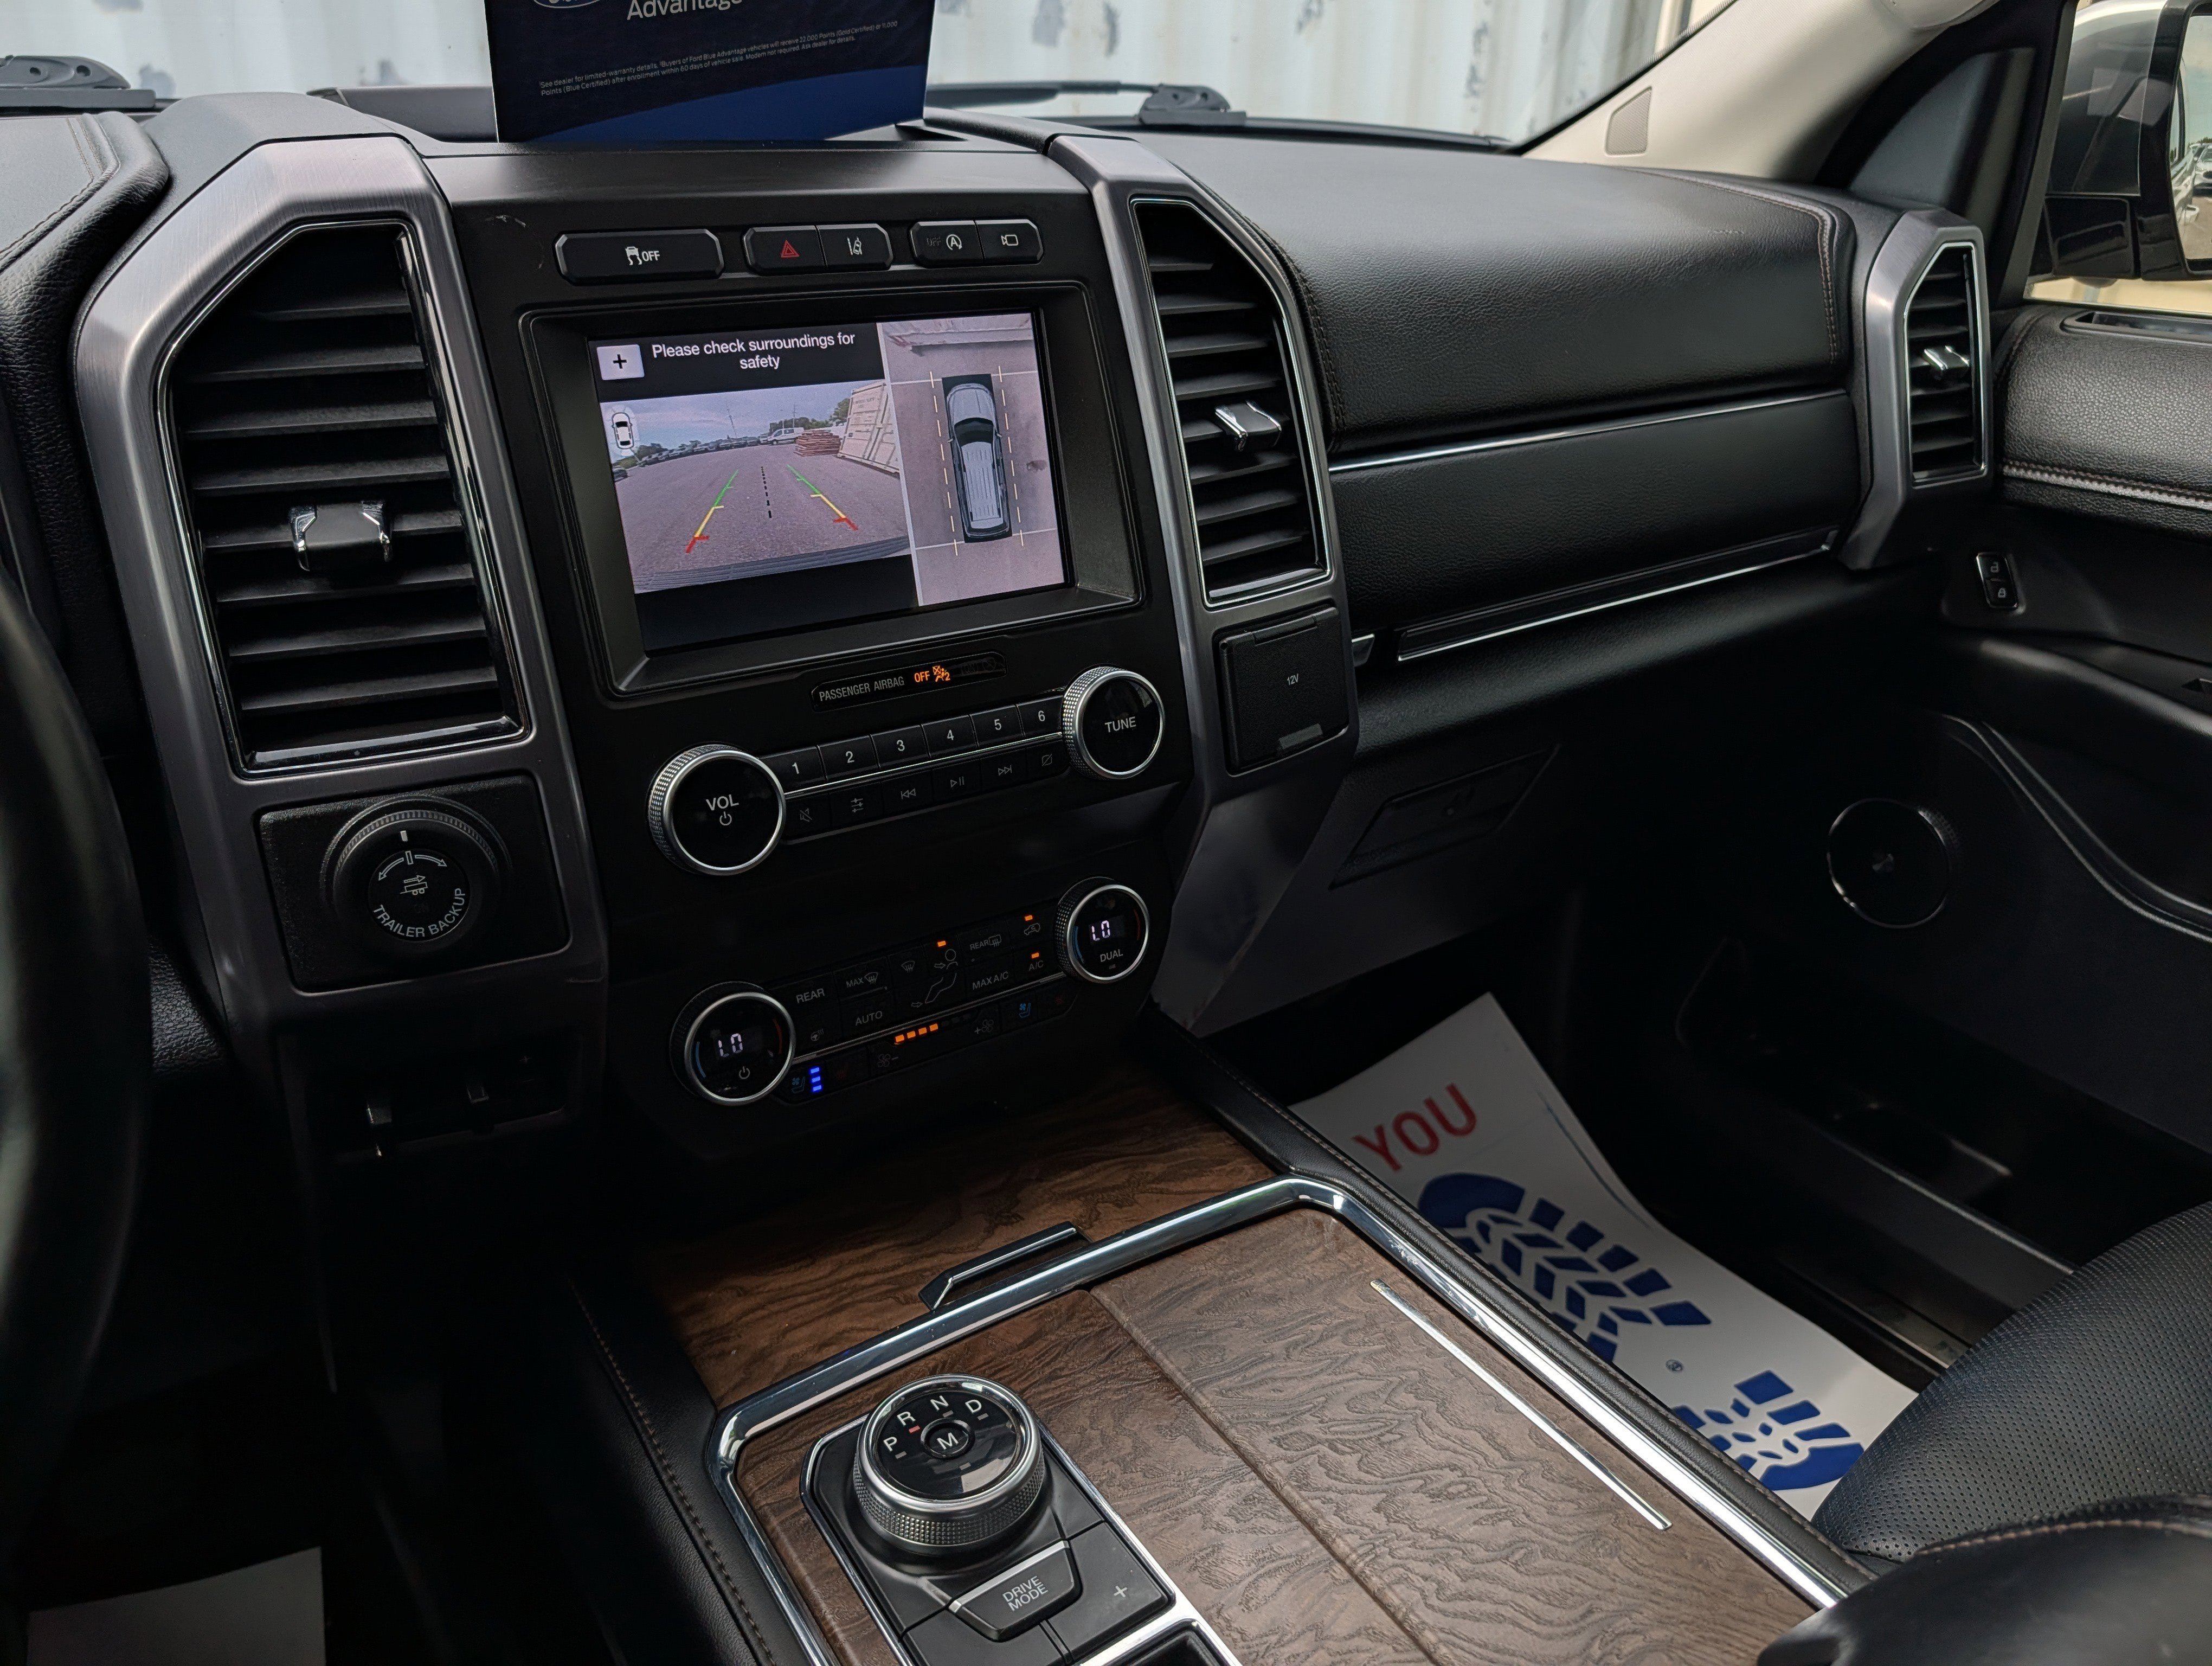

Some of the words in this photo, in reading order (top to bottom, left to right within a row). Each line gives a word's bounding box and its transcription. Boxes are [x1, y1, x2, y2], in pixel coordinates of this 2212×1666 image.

[636, 63, 658, 72] details.
[703, 52, 716, 60] Blue
[717, 48, 747, 57] Advantage
[747, 43, 769, 52] vehicles
[563, 84, 580, 93] (Blue
[581, 78, 611, 89] Certified)
[627, 70, 660, 81] enrollment
[661, 67, 680, 75] within
[711, 58, 731, 66] vehicle
[642, 251, 660, 262] OFF
[652, 343, 700, 358] Please
[703, 338, 746, 355] check
[748, 334, 834, 352] surroundings
[837, 331, 855, 347] for
[739, 354, 780, 370] safety
[819, 685, 871, 701] PASSENGER
[873, 676, 905, 691] AIRBAG
[914, 671, 930, 683] OFF
[1287, 673, 1299, 685] 12V
[1104, 716, 1137, 733] TUNE
[792, 762, 800, 774] 1
[845, 751, 854, 764] 2
[896, 739, 906, 752] 3
[946, 729, 955, 741] 4
[994, 719, 1002, 731] 5
[1038, 710, 1046, 722] 6
[705, 794, 740, 811] VOL
[373, 904, 426, 938] TRAILER
[428, 887, 466, 935] BACKUP
[969, 939, 989, 951] REAR
[1099, 949, 1124, 963] DUAL
[1028, 960, 1044, 972] A/C
[846, 977, 865, 988] MAX
[972, 976, 993, 990] MAX
[993, 970, 1009, 983] A/C
[796, 988, 825, 1004] REAR
[856, 1010, 883, 1026] AUTO
[1353, 1082, 1477, 1171] YOU
[930, 1395, 949, 1411] N
[964, 1399, 982, 1414] D
[896, 1411, 916, 1426] R
[883, 1436, 898, 1452] P
[936, 1432, 959, 1450] M
[1002, 1575, 1042, 1602] DRIVE
[1008, 1584, 1049, 1611] MODE
